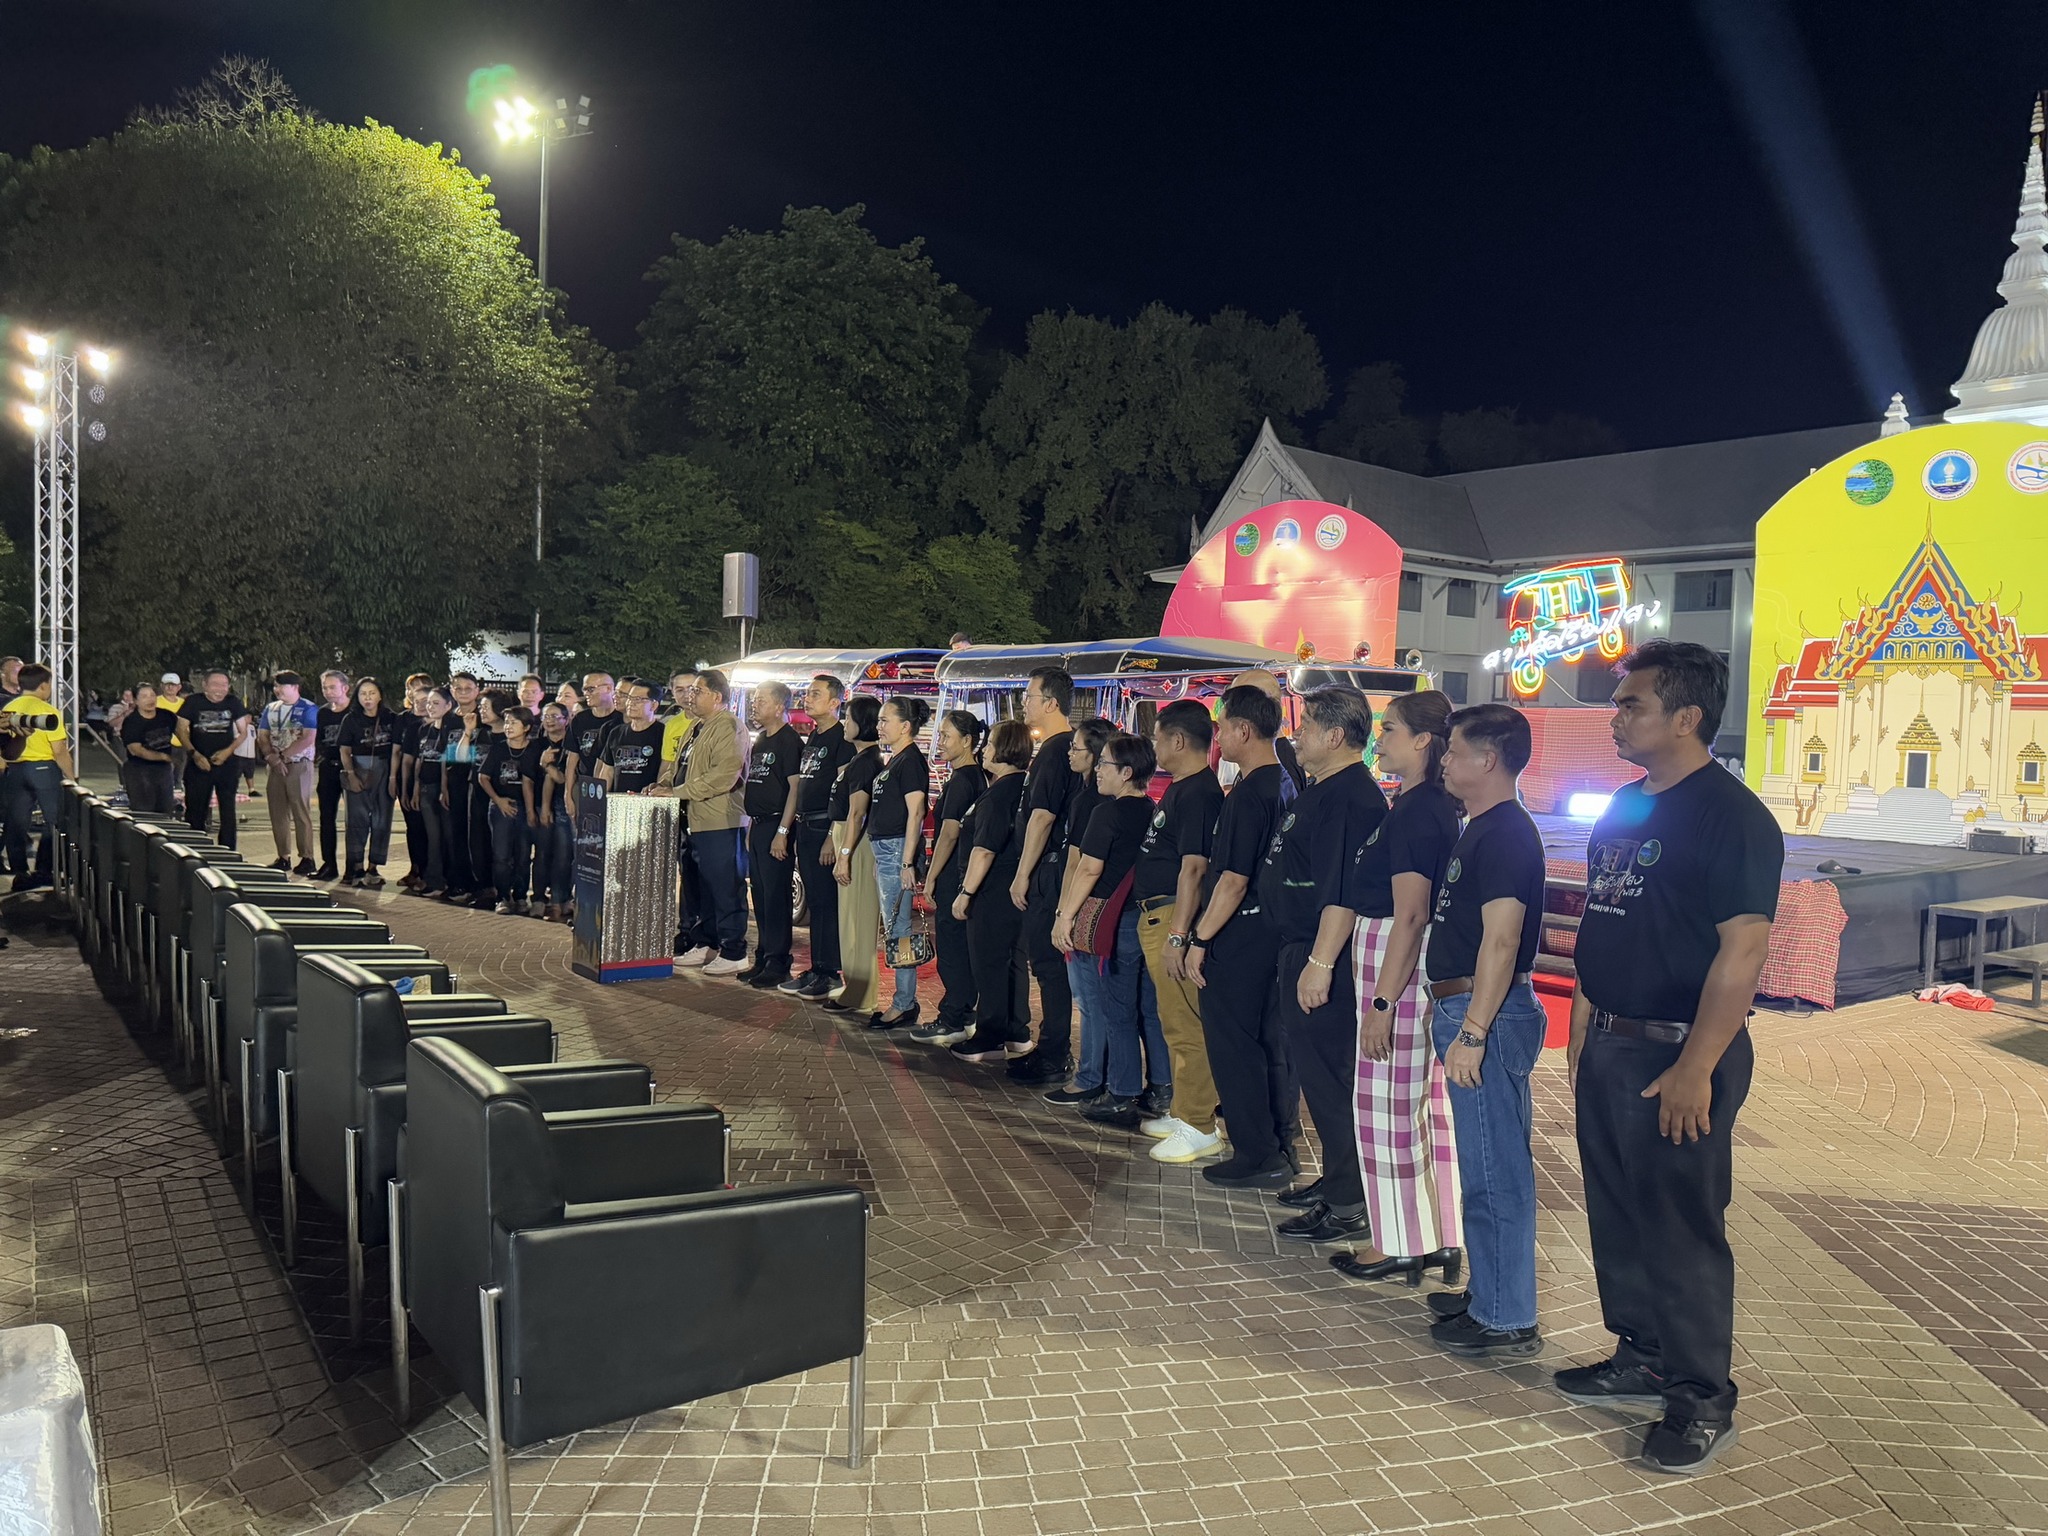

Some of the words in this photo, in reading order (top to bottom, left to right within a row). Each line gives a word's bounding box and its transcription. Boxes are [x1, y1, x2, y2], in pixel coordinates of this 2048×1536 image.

[1482, 599, 1661, 669] สามล้อเรืองแสง
